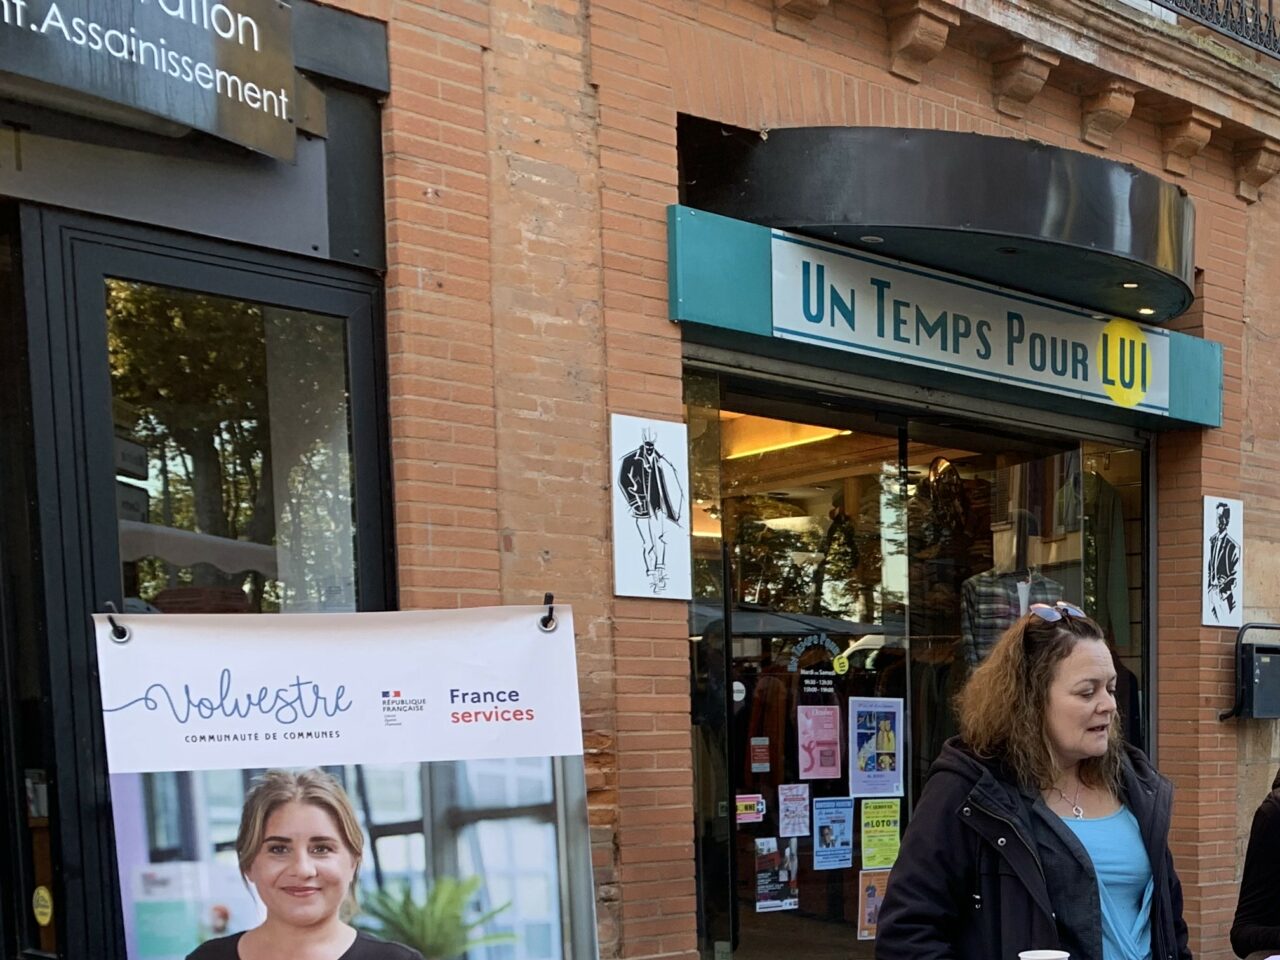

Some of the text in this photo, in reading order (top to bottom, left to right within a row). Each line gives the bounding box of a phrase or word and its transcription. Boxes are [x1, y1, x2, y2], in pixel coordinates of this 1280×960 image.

[1102, 332, 1148, 393] LUI
[142, 668, 353, 724] Volvestre
[382, 698, 427, 706] RÉPUBLIQUE
[450, 689, 520, 704] France
[382, 705, 424, 713] FRANÇAISE
[451, 706, 535, 724] services
[184, 730, 341, 743] COMMUNAUTÉ DE COMMUNES
[871, 819, 891, 827] LOTO
